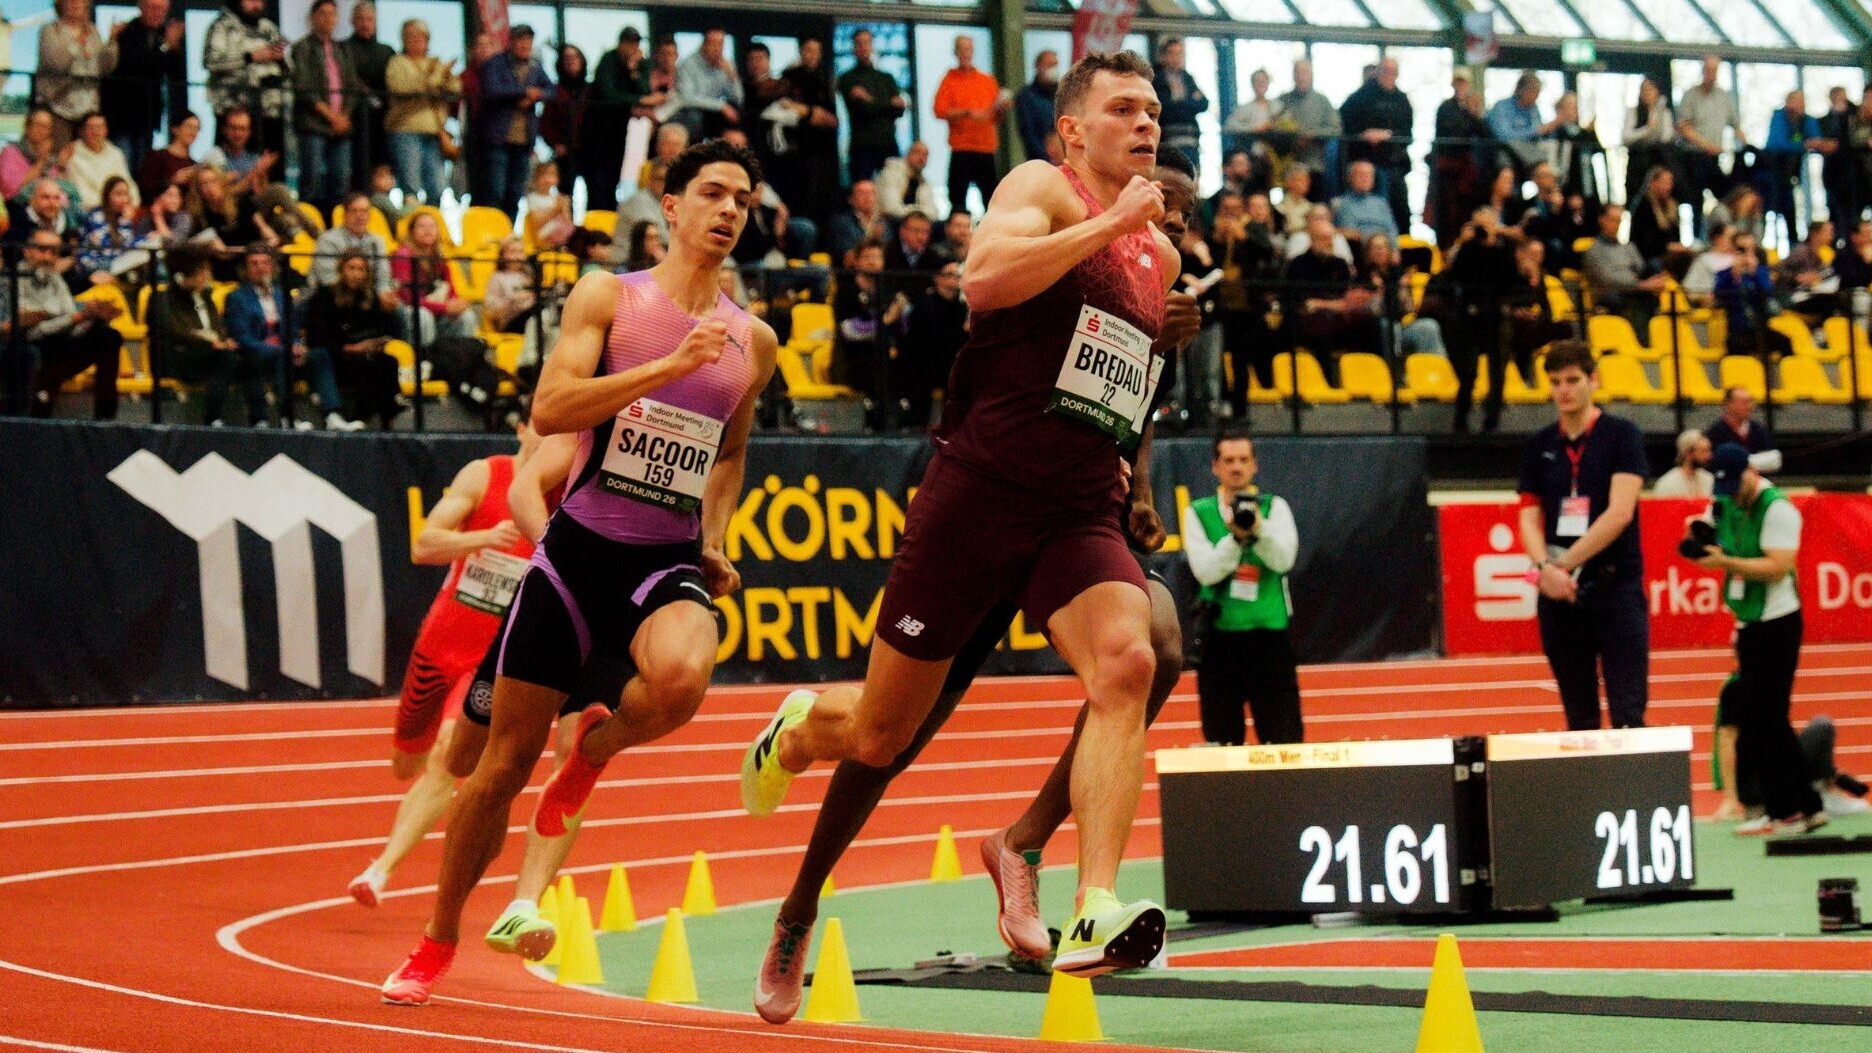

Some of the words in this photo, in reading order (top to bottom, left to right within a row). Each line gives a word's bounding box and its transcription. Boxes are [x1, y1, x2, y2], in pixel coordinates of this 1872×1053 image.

[1102, 329, 1129, 347] Dortmund
[1104, 319, 1124, 333] Indoor
[1124, 328, 1141, 345] Meeting
[1074, 342, 1142, 396] BREDAU
[1100, 383, 1116, 406] 22
[646, 414, 684, 431] Dortmund
[649, 404, 674, 418] Indoor
[675, 412, 703, 428] Meeting
[1060, 397, 1105, 422] DORTMUND
[1105, 415, 1115, 427] 26
[618, 428, 709, 476] SACOOR
[643, 463, 675, 487] 159
[606, 478, 661, 501] DORTMUND
[662, 494, 676, 505] 26
[725, 474, 918, 562] KÖRN
[1817, 561, 1872, 610] Do
[1595, 805, 1693, 888] 21.61
[1300, 823, 1449, 904] 21.61
